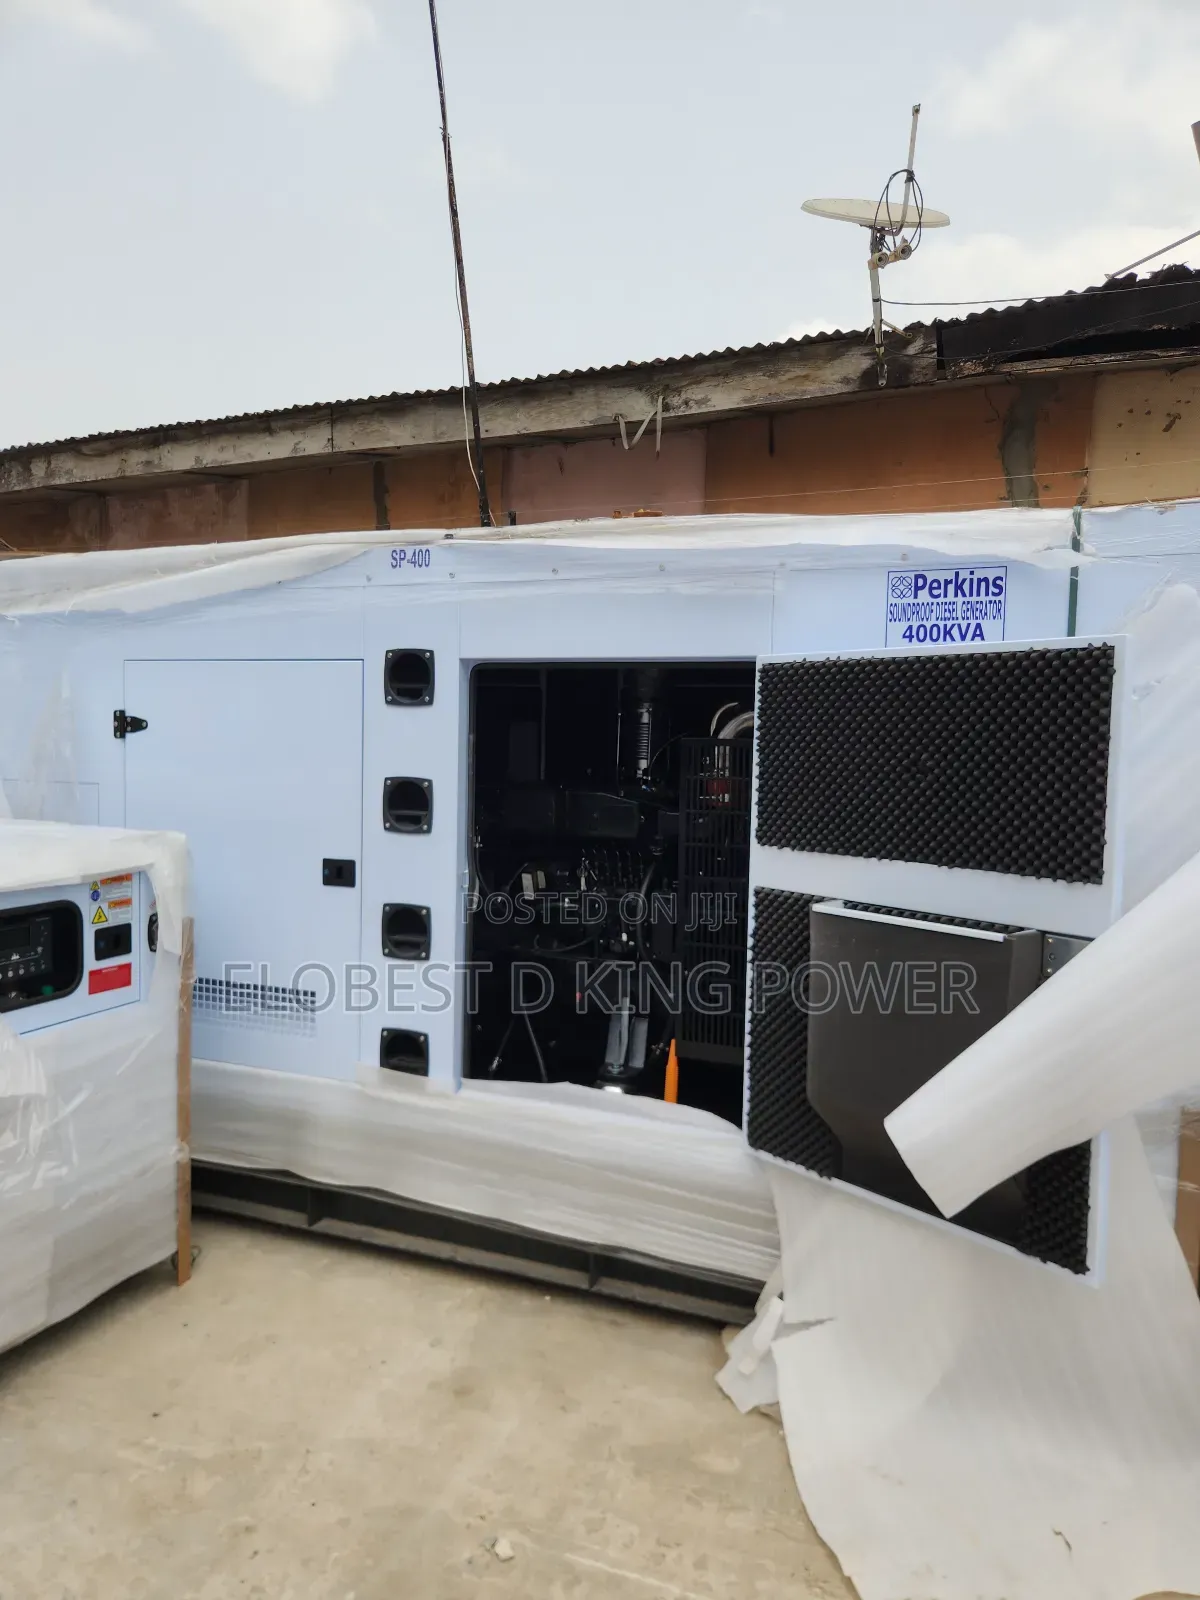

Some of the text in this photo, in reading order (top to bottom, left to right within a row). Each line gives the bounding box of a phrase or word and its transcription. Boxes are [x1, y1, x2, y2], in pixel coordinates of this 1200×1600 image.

[391, 548, 430, 569] SP-400
[913, 570, 1004, 599] Perkins
[888, 600, 1002, 622] SOUNDPROOF DIESEL GENERATOR
[902, 622, 985, 643] 400KVA
